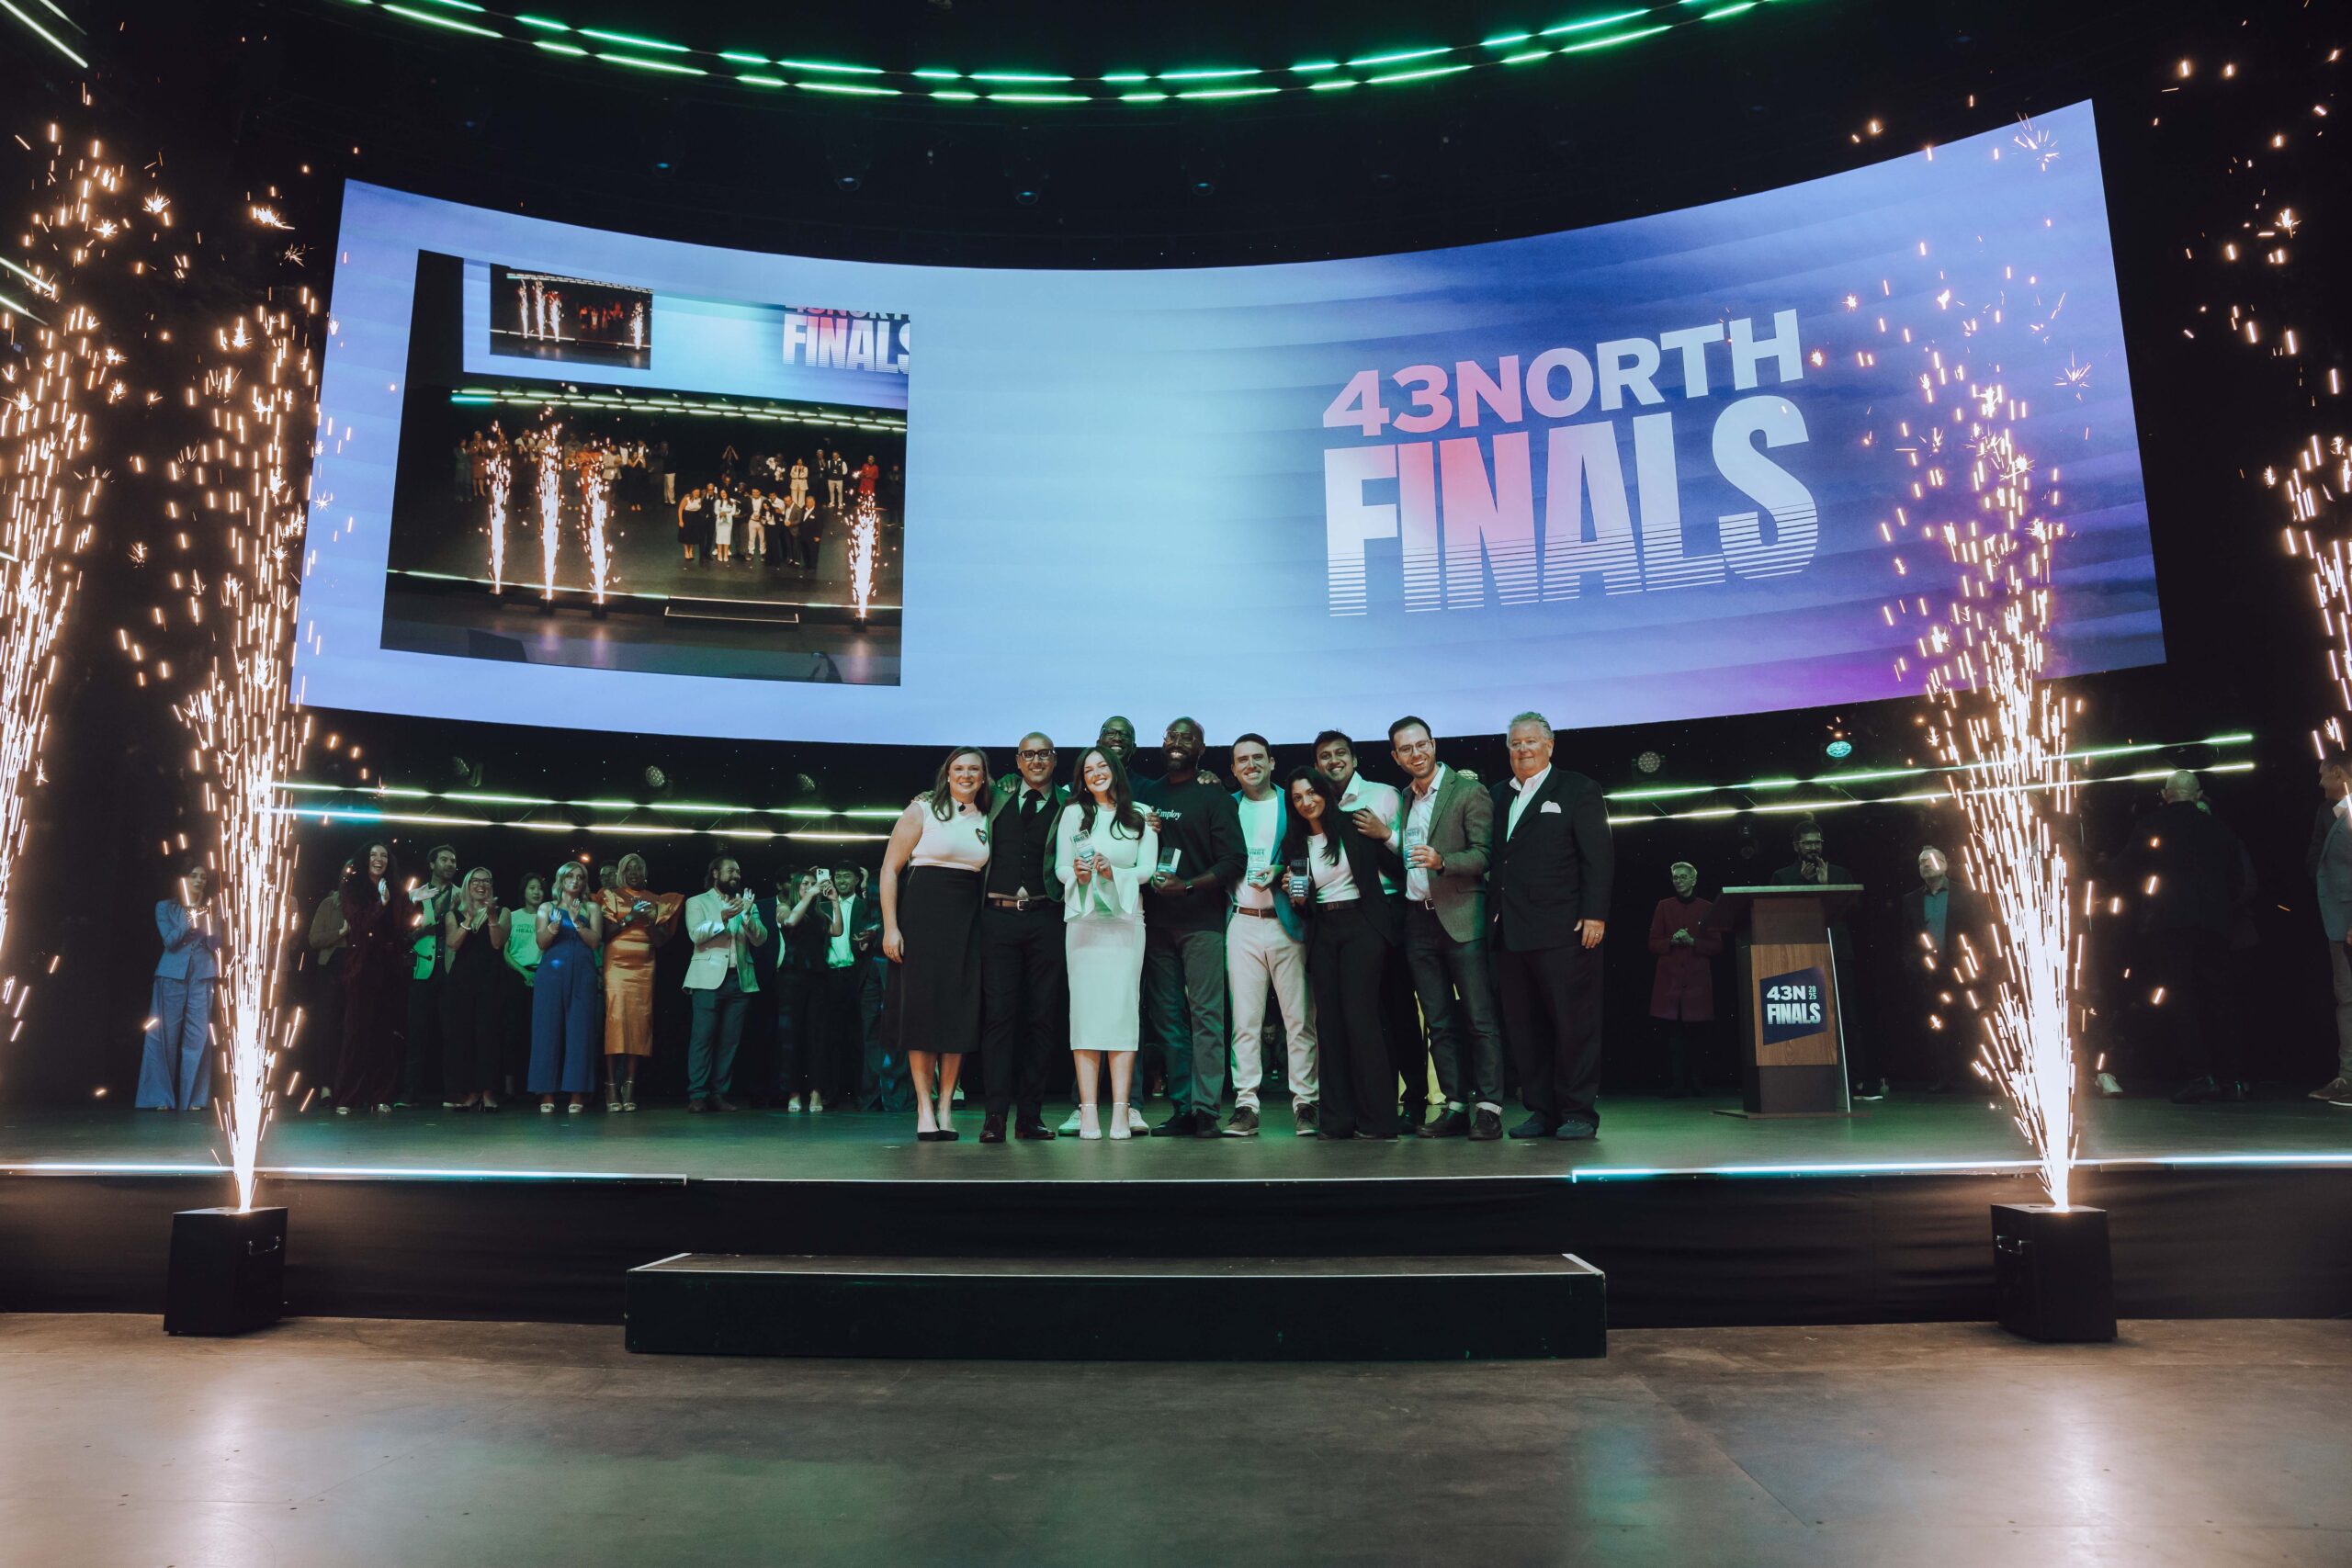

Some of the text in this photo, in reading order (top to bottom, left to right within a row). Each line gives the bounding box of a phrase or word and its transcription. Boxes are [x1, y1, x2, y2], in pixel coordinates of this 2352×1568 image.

[1323, 309, 1804, 436] 43NORTH
[1323, 395, 1818, 616] FINALS
[1157, 808, 1182, 820] Employ
[1767, 986, 1806, 1000] 43N
[1767, 1002, 1821, 1025] FINALS
